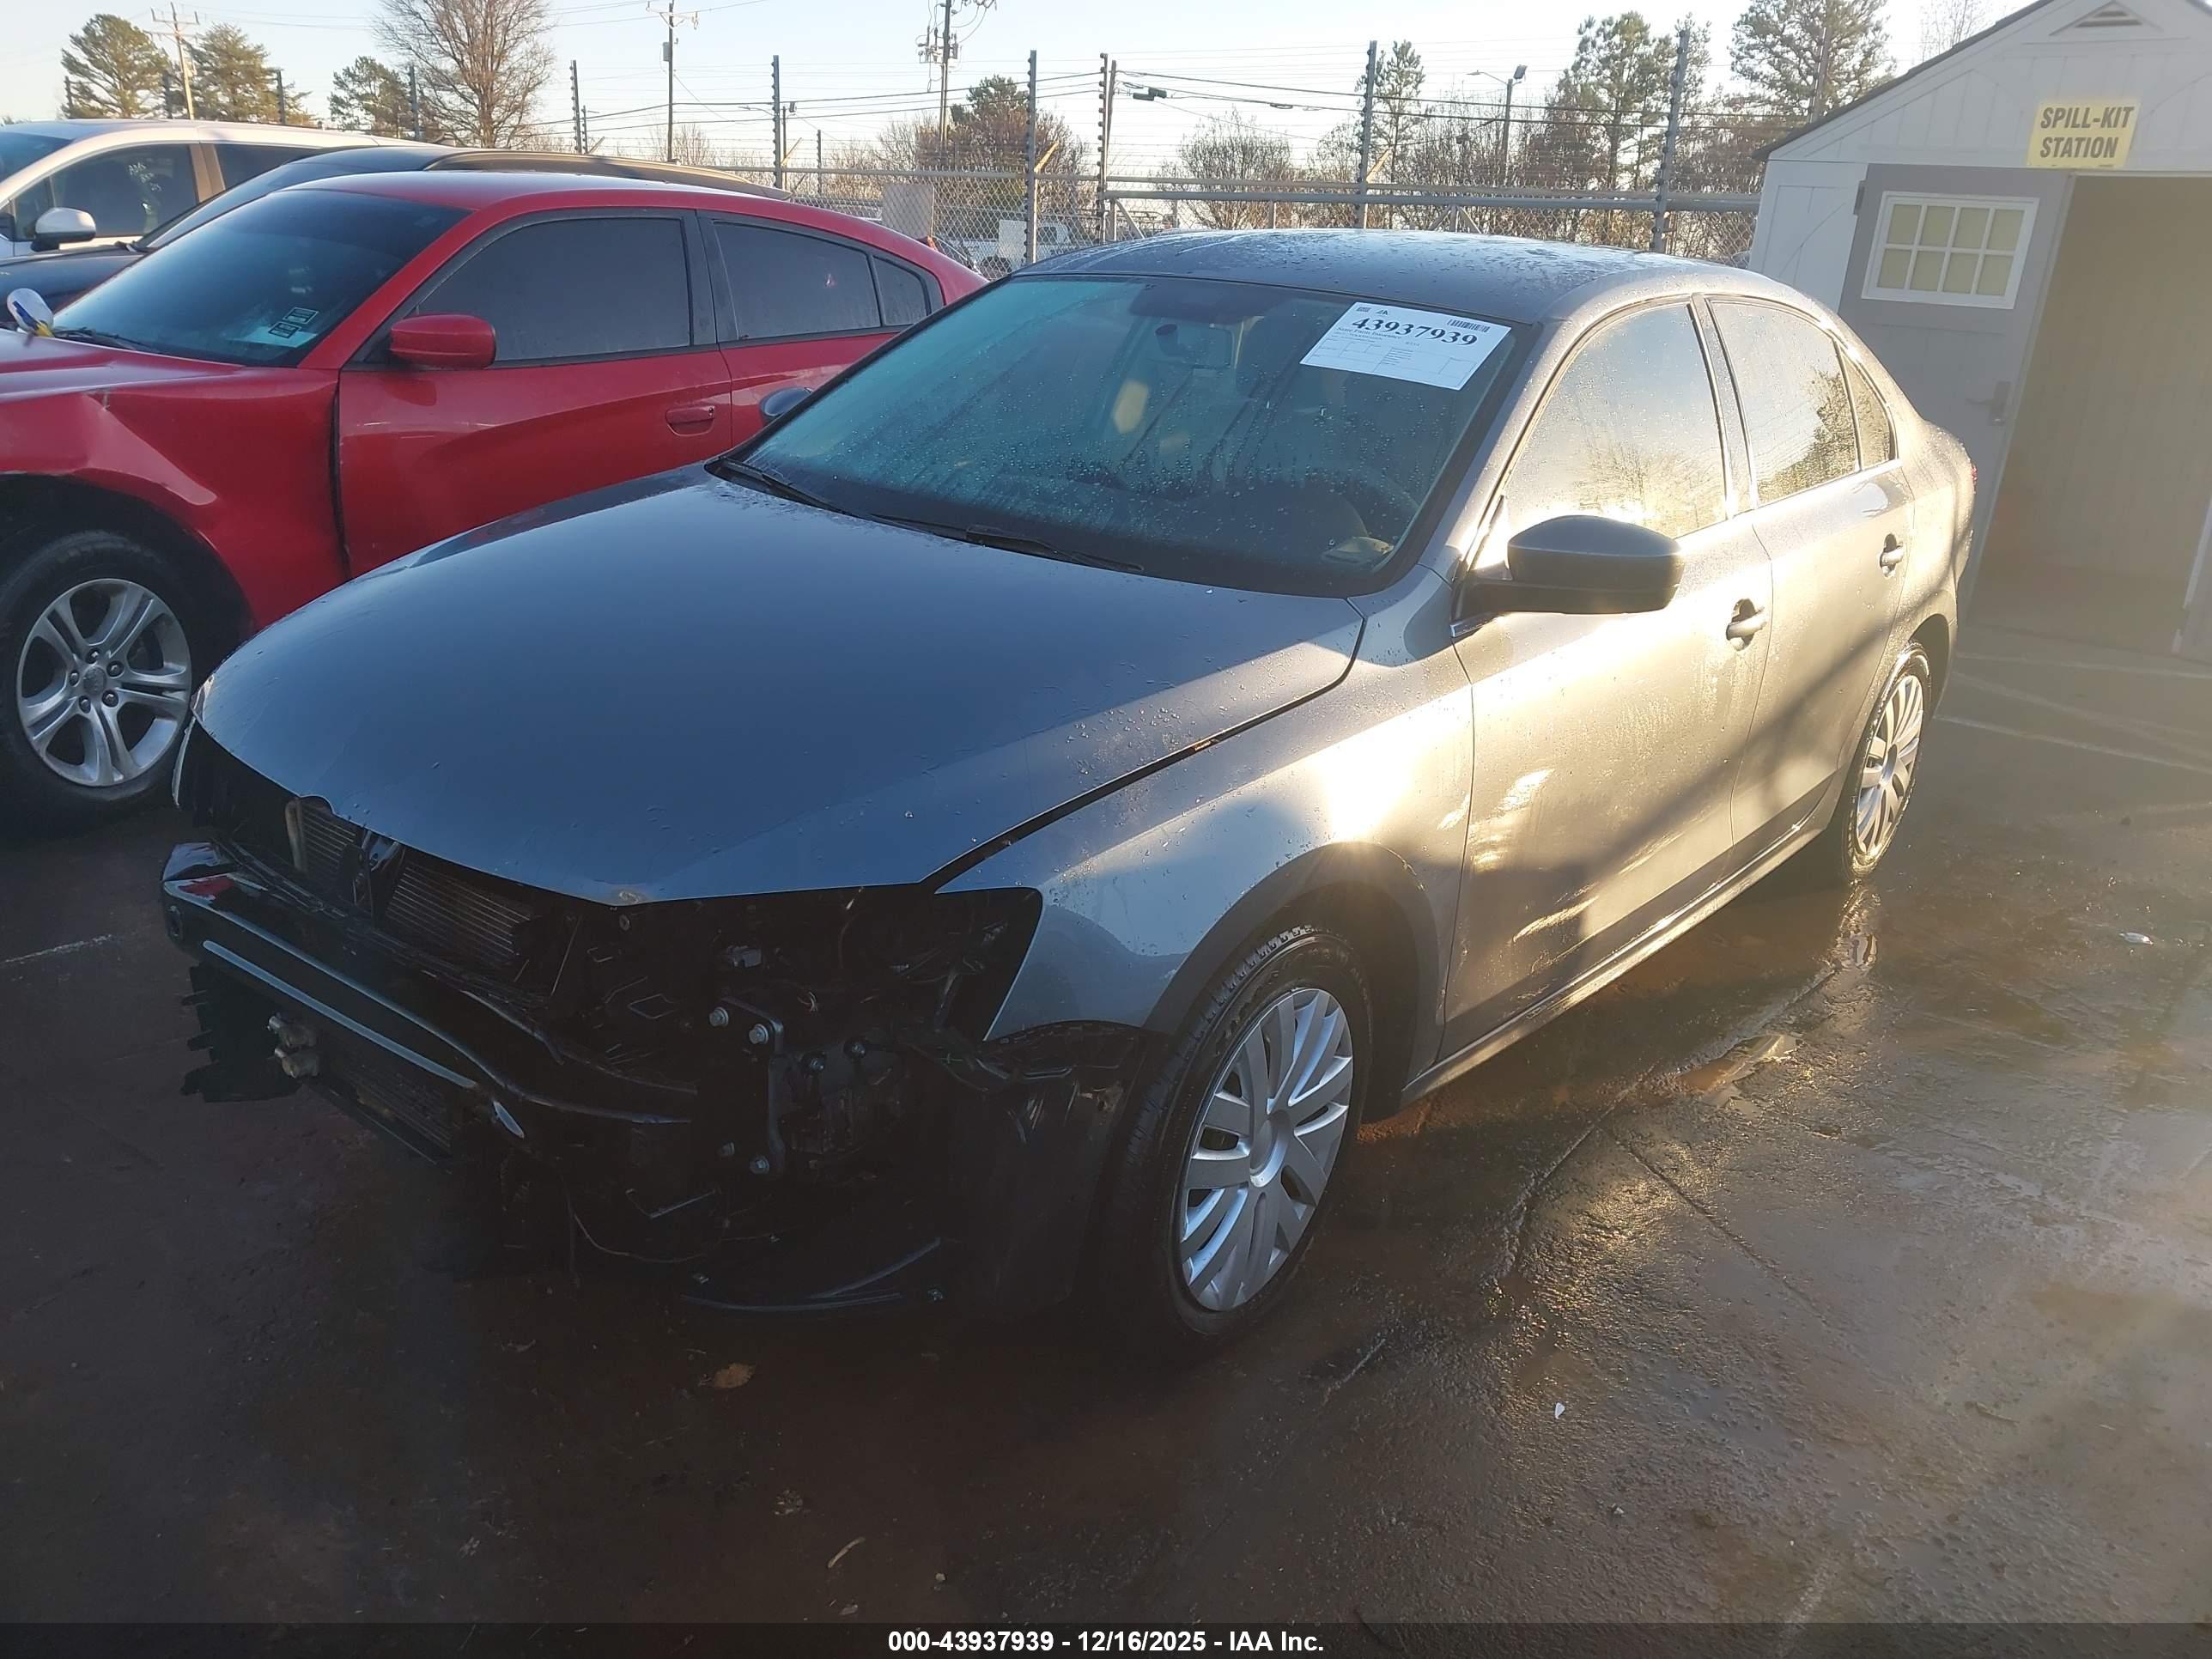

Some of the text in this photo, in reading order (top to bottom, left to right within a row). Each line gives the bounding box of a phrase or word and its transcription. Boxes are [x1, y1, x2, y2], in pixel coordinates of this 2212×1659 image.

[2039, 106, 2135, 130] SPILL-KIT
[2039, 136, 2119, 159] STATION
[1352, 317, 1478, 346] 43937939
